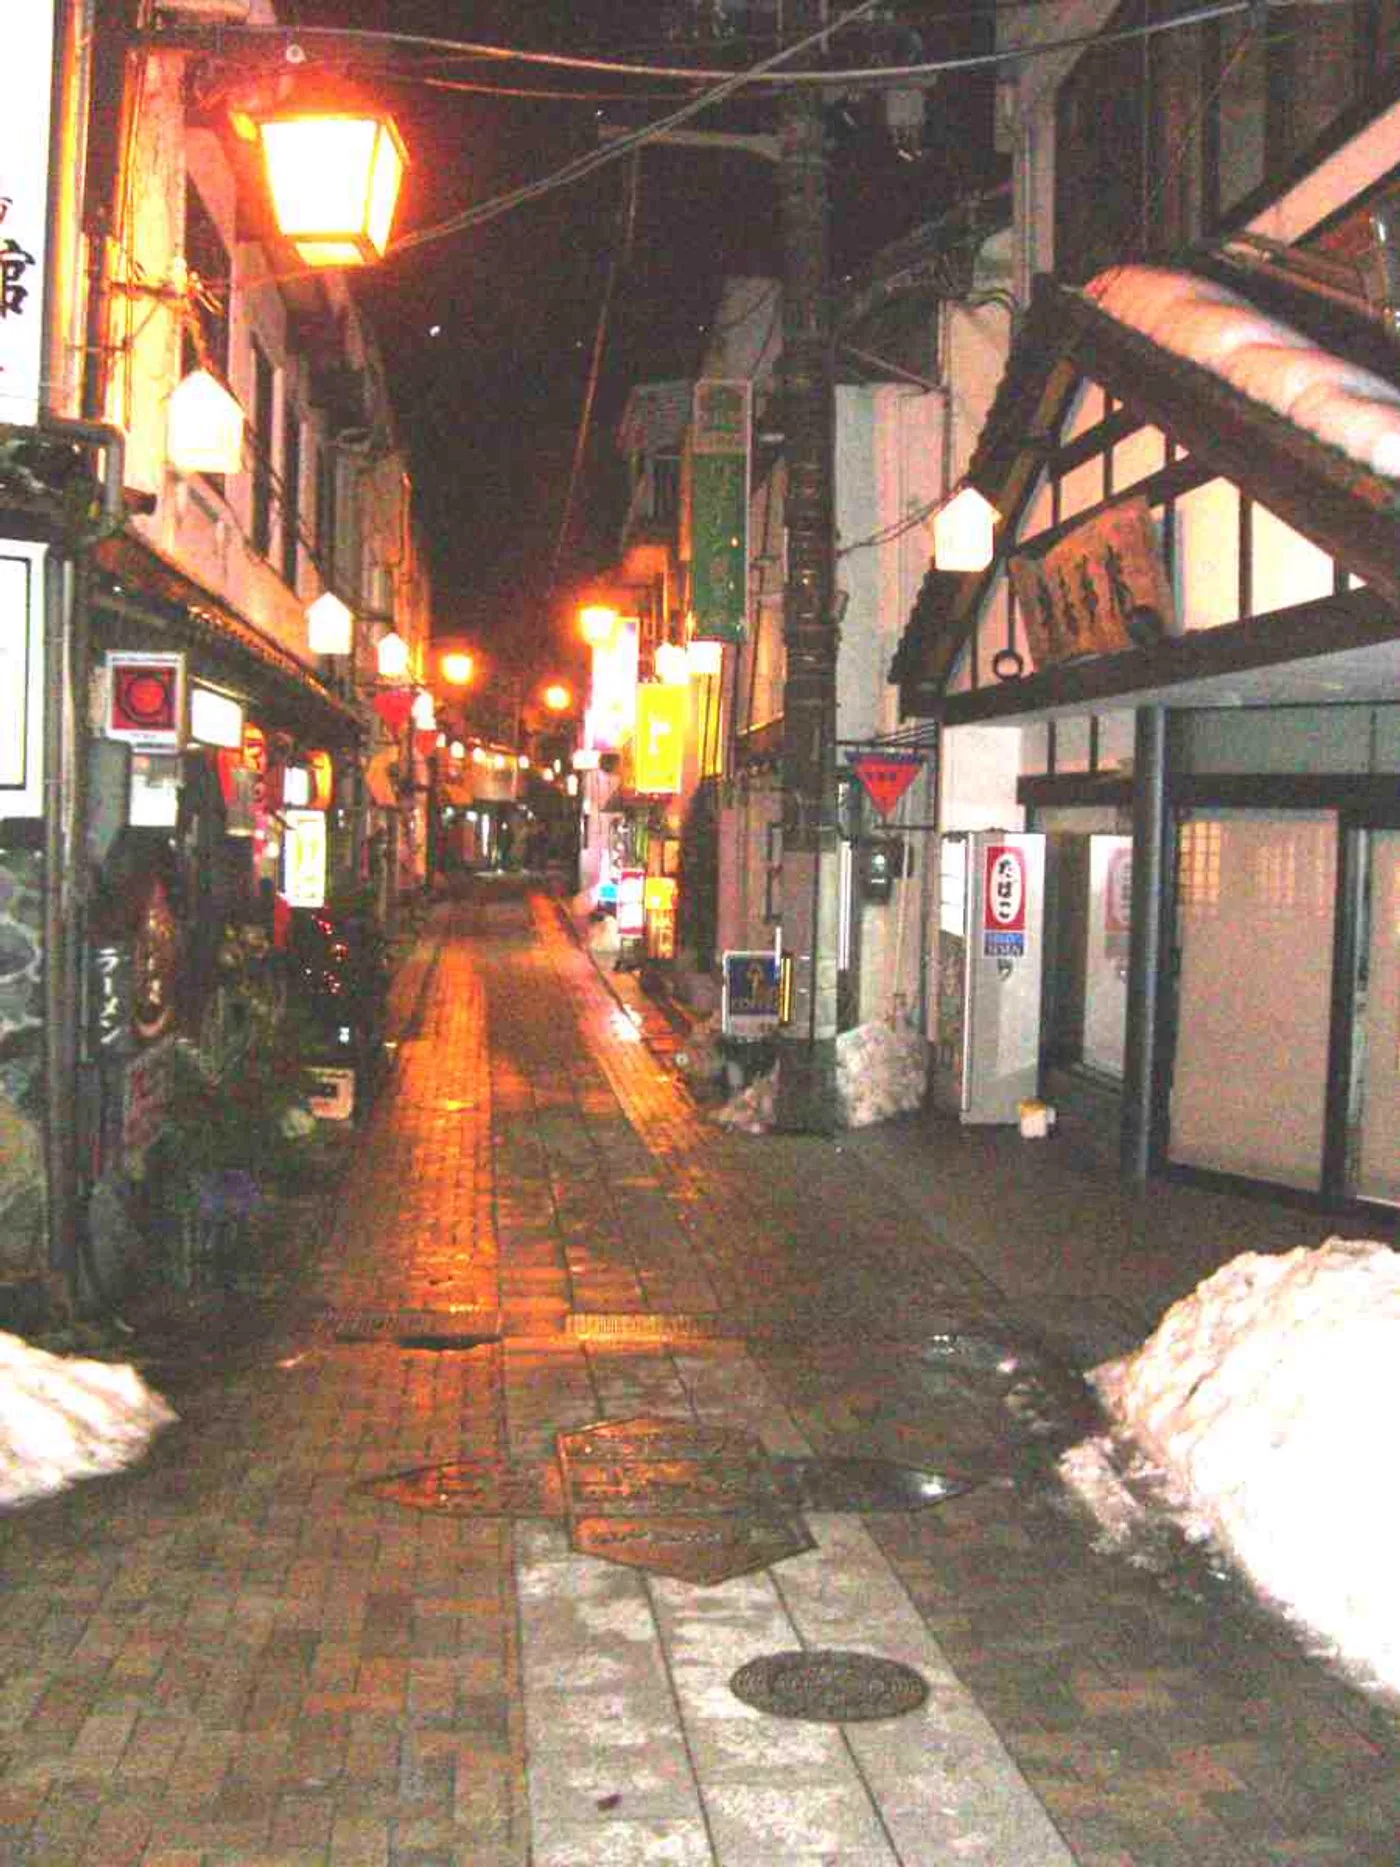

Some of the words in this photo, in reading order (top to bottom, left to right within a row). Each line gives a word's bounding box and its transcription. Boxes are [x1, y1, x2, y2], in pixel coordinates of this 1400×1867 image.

[997, 859, 1013, 919] たばこ
[98, 948, 120, 1044] ラーメン
